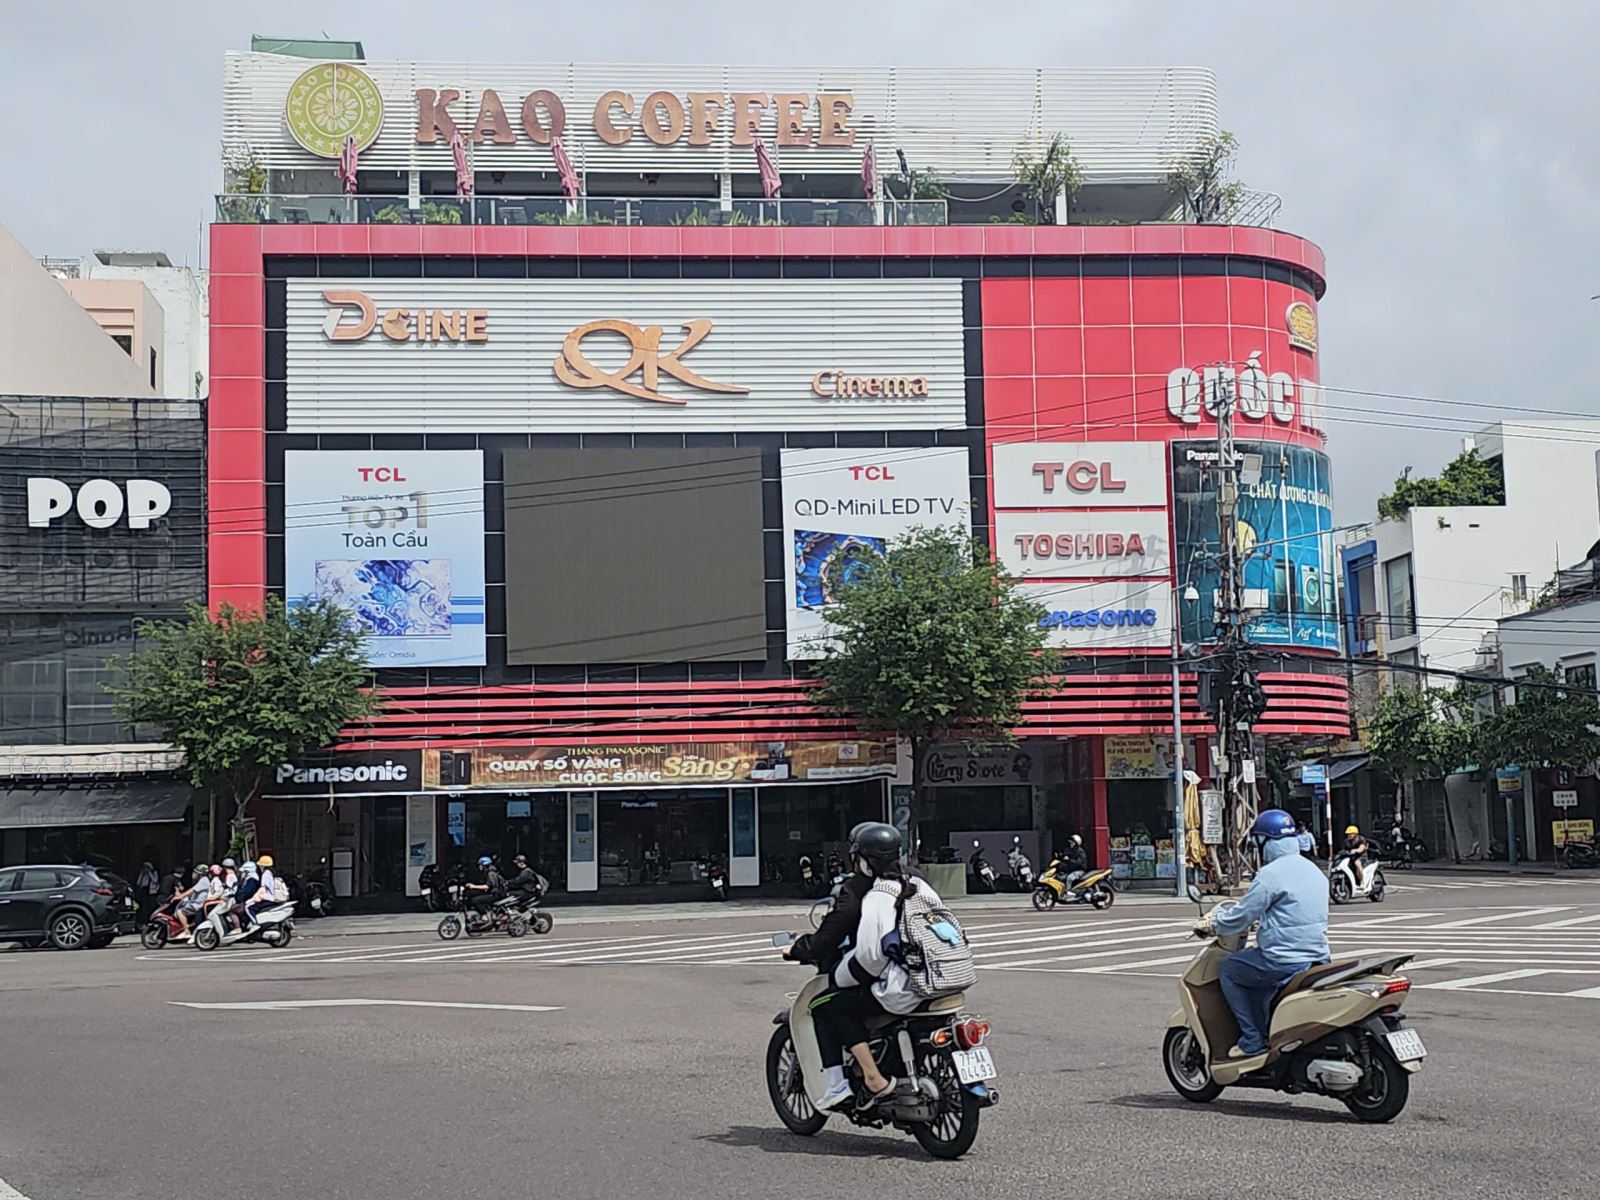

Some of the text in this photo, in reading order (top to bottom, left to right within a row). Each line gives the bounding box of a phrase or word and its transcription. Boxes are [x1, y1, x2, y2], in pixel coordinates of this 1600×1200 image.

[291, 68, 376, 107] KAO COFFEE
[415, 88, 856, 148] KAO COFFEE
[553, 319, 750, 405] QK
[812, 369, 929, 398] Cinema
[1167, 351, 1295, 423] QUỐC
[1186, 450, 1244, 461] Panasic
[358, 467, 406, 482] TCL
[849, 466, 895, 481] TCL
[1033, 460, 1127, 493] TCL
[27, 477, 172, 529] POP
[923, 498, 954, 514] TV
[341, 529, 428, 548] Toàn Cầu
[1014, 533, 1146, 558] TOSHIBA
[1039, 608, 1158, 628] anasonic
[566, 745, 666, 755] THÁNG PANASONIC
[8, 755, 48, 773] TEA
[276, 760, 407, 784] Panasonic
[489, 755, 622, 773] QUAY SỐ VÀNG
[967, 759, 1006, 778] Sore
[558, 768, 662, 785] CUỘC SỐNG
